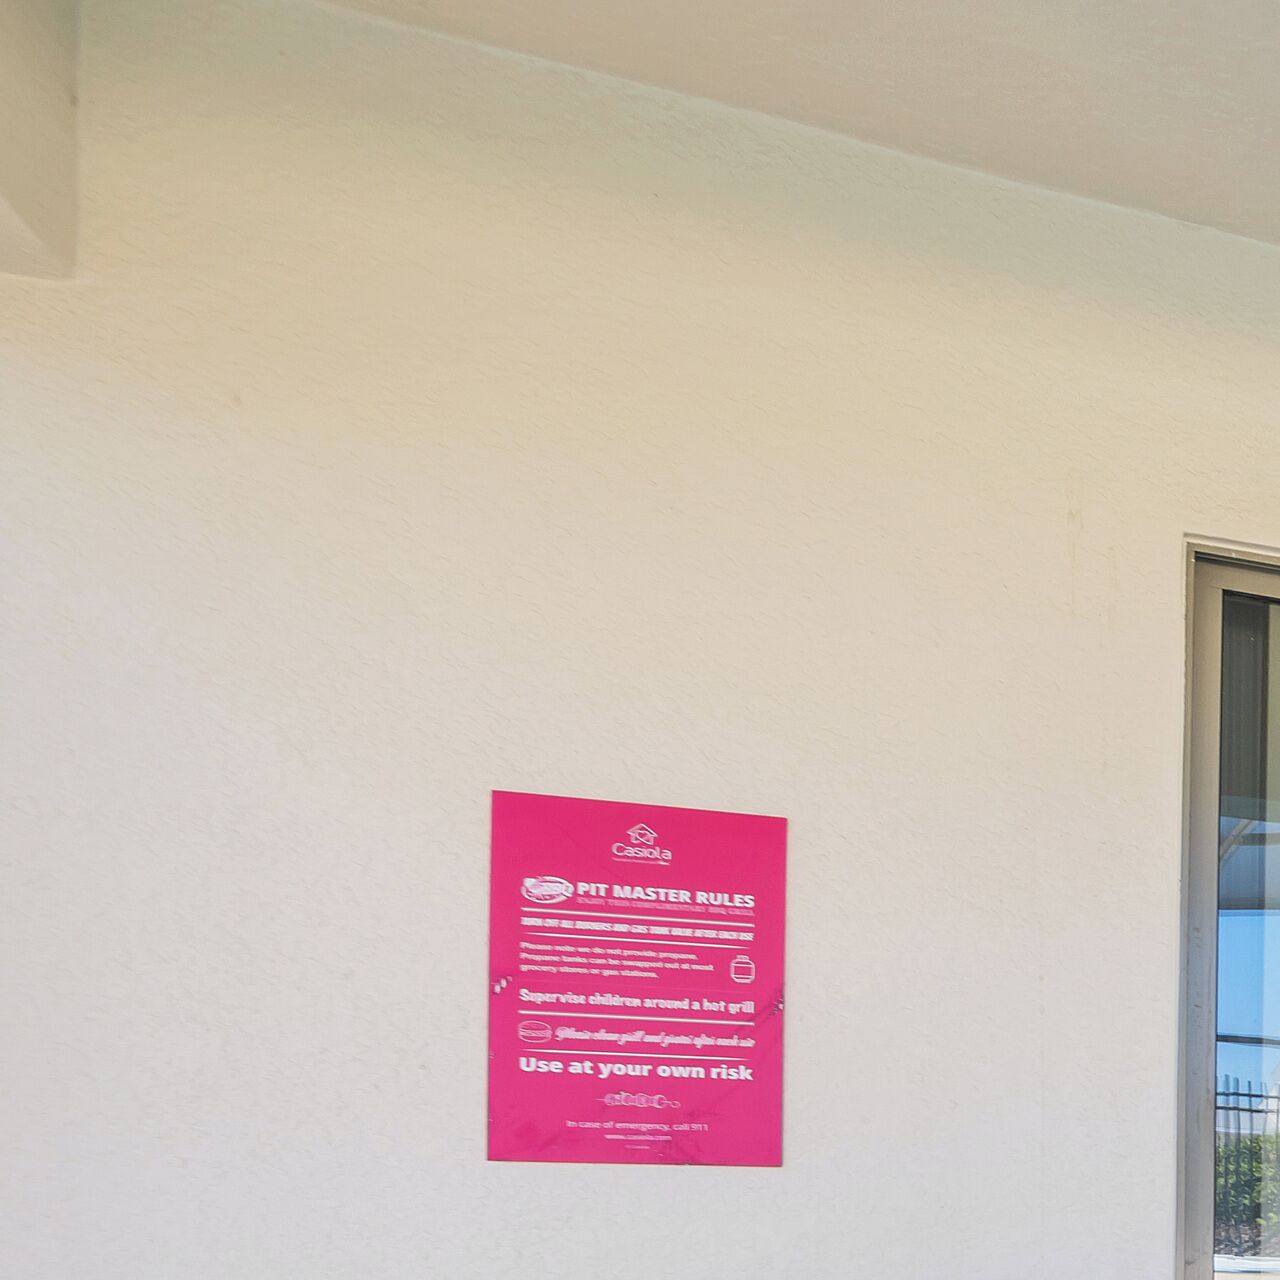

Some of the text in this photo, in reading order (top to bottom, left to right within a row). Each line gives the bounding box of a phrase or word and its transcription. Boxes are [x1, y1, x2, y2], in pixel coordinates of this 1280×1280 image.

[612, 842, 672, 860] Casiola
[576, 881, 609, 897] PIT
[612, 884, 692, 904] MASTER
[695, 890, 756, 908] RULES
[519, 988, 755, 1014] Supervise children around a hot grill
[519, 1056, 754, 1081] Use at your own risk
